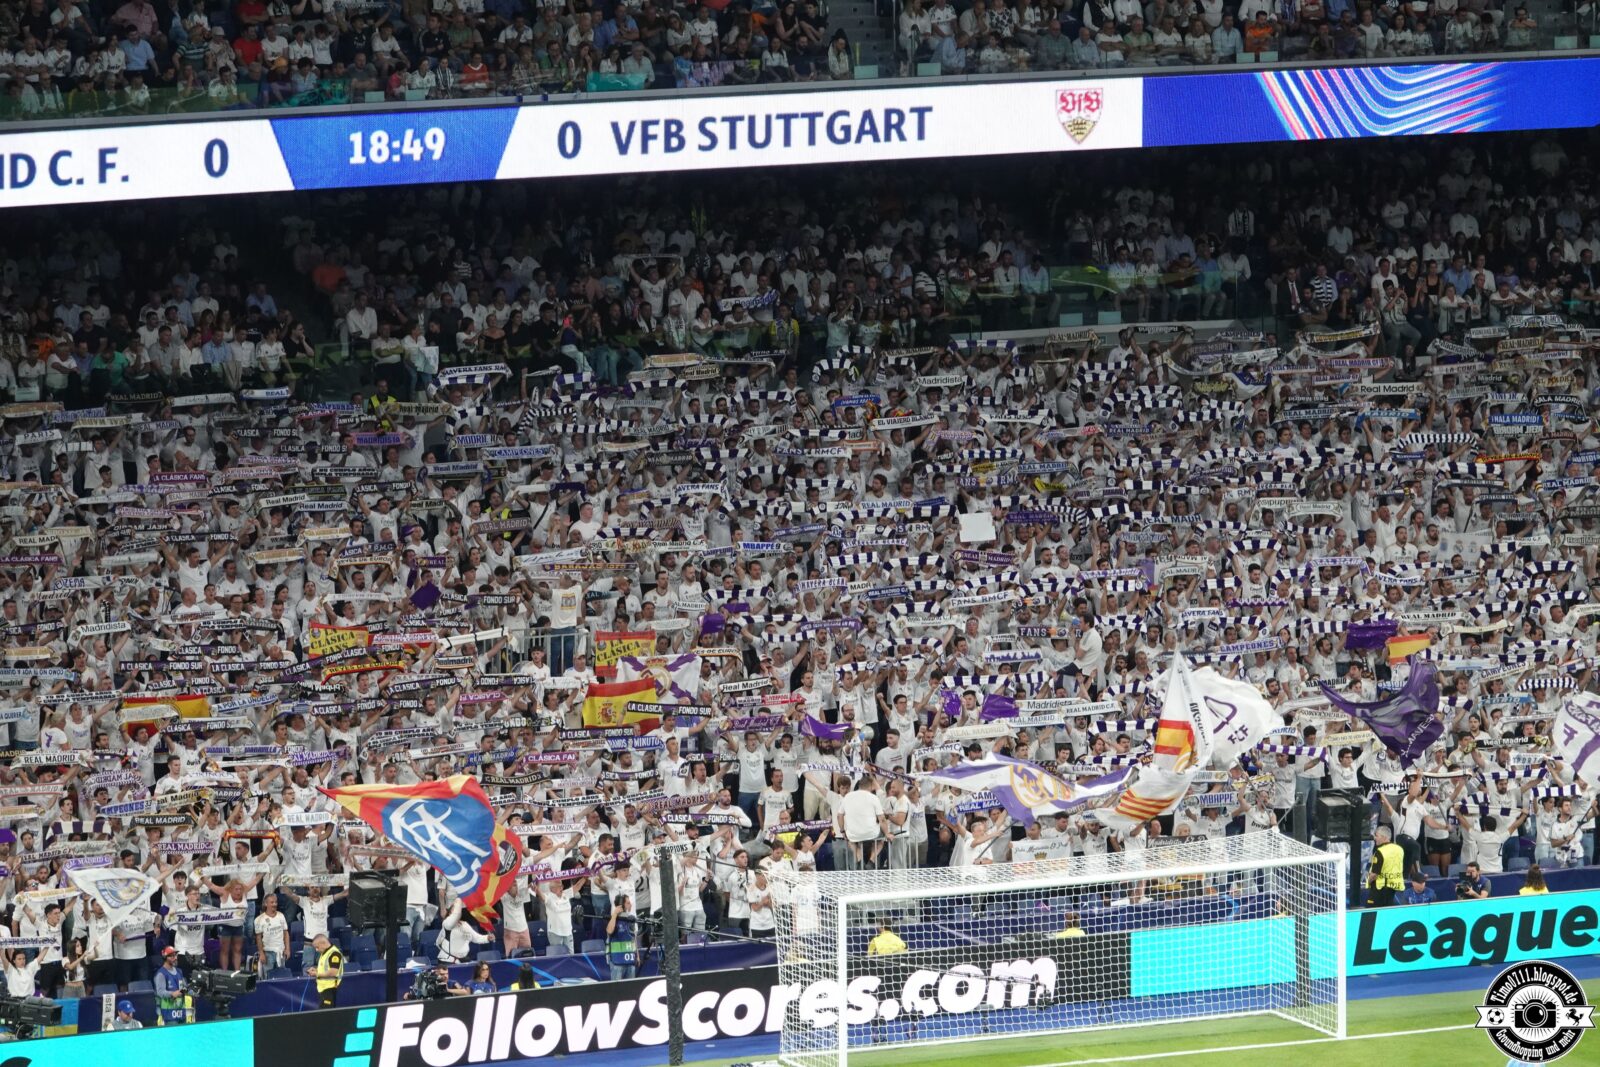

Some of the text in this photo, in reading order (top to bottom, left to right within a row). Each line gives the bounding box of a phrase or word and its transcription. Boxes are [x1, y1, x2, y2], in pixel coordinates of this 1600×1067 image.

[611, 106, 933, 157] VFB STUTTGART
[557, 120, 582, 160] 0
[348, 127, 445, 166] 18:49
[204, 137, 230, 178] 0
[48, 150, 85, 187] C.
[99, 148, 130, 184] F.
[1384, 384, 1415, 392] Madrid
[887, 416, 910, 425] VIAJERO
[777, 447, 842, 455] FANS RMCF
[282, 495, 305, 503] Madrid
[882, 500, 911, 508] MADRID
[500, 519, 527, 528] MADRID
[952, 593, 1008, 606] FANS RMCF
[81, 622, 126, 633] Madridista
[1020, 628, 1047, 636] FANS
[1221, 640, 1274, 652] CAMPEONES
[1481, 662, 1526, 678] CAMPEONES
[742, 679, 768, 689] Madrid
[400, 700, 417, 708] FONDO
[1028, 700, 1072, 709] Madridista
[1082, 704, 1105, 712] MADRID
[679, 707, 697, 715] FONDO
[1028, 715, 1054, 723] MADRID
[605, 728, 622, 736] FONDO
[25, 754, 75, 764] REAL MADRID
[507, 775, 536, 783] MADRID
[655, 796, 704, 809] REAL MADRID
[156, 816, 185, 824] MADRID
[708, 815, 727, 823] FONDO
[201, 912, 233, 921] Madrid
[379, 958, 1056, 1067] FollowScores.com
